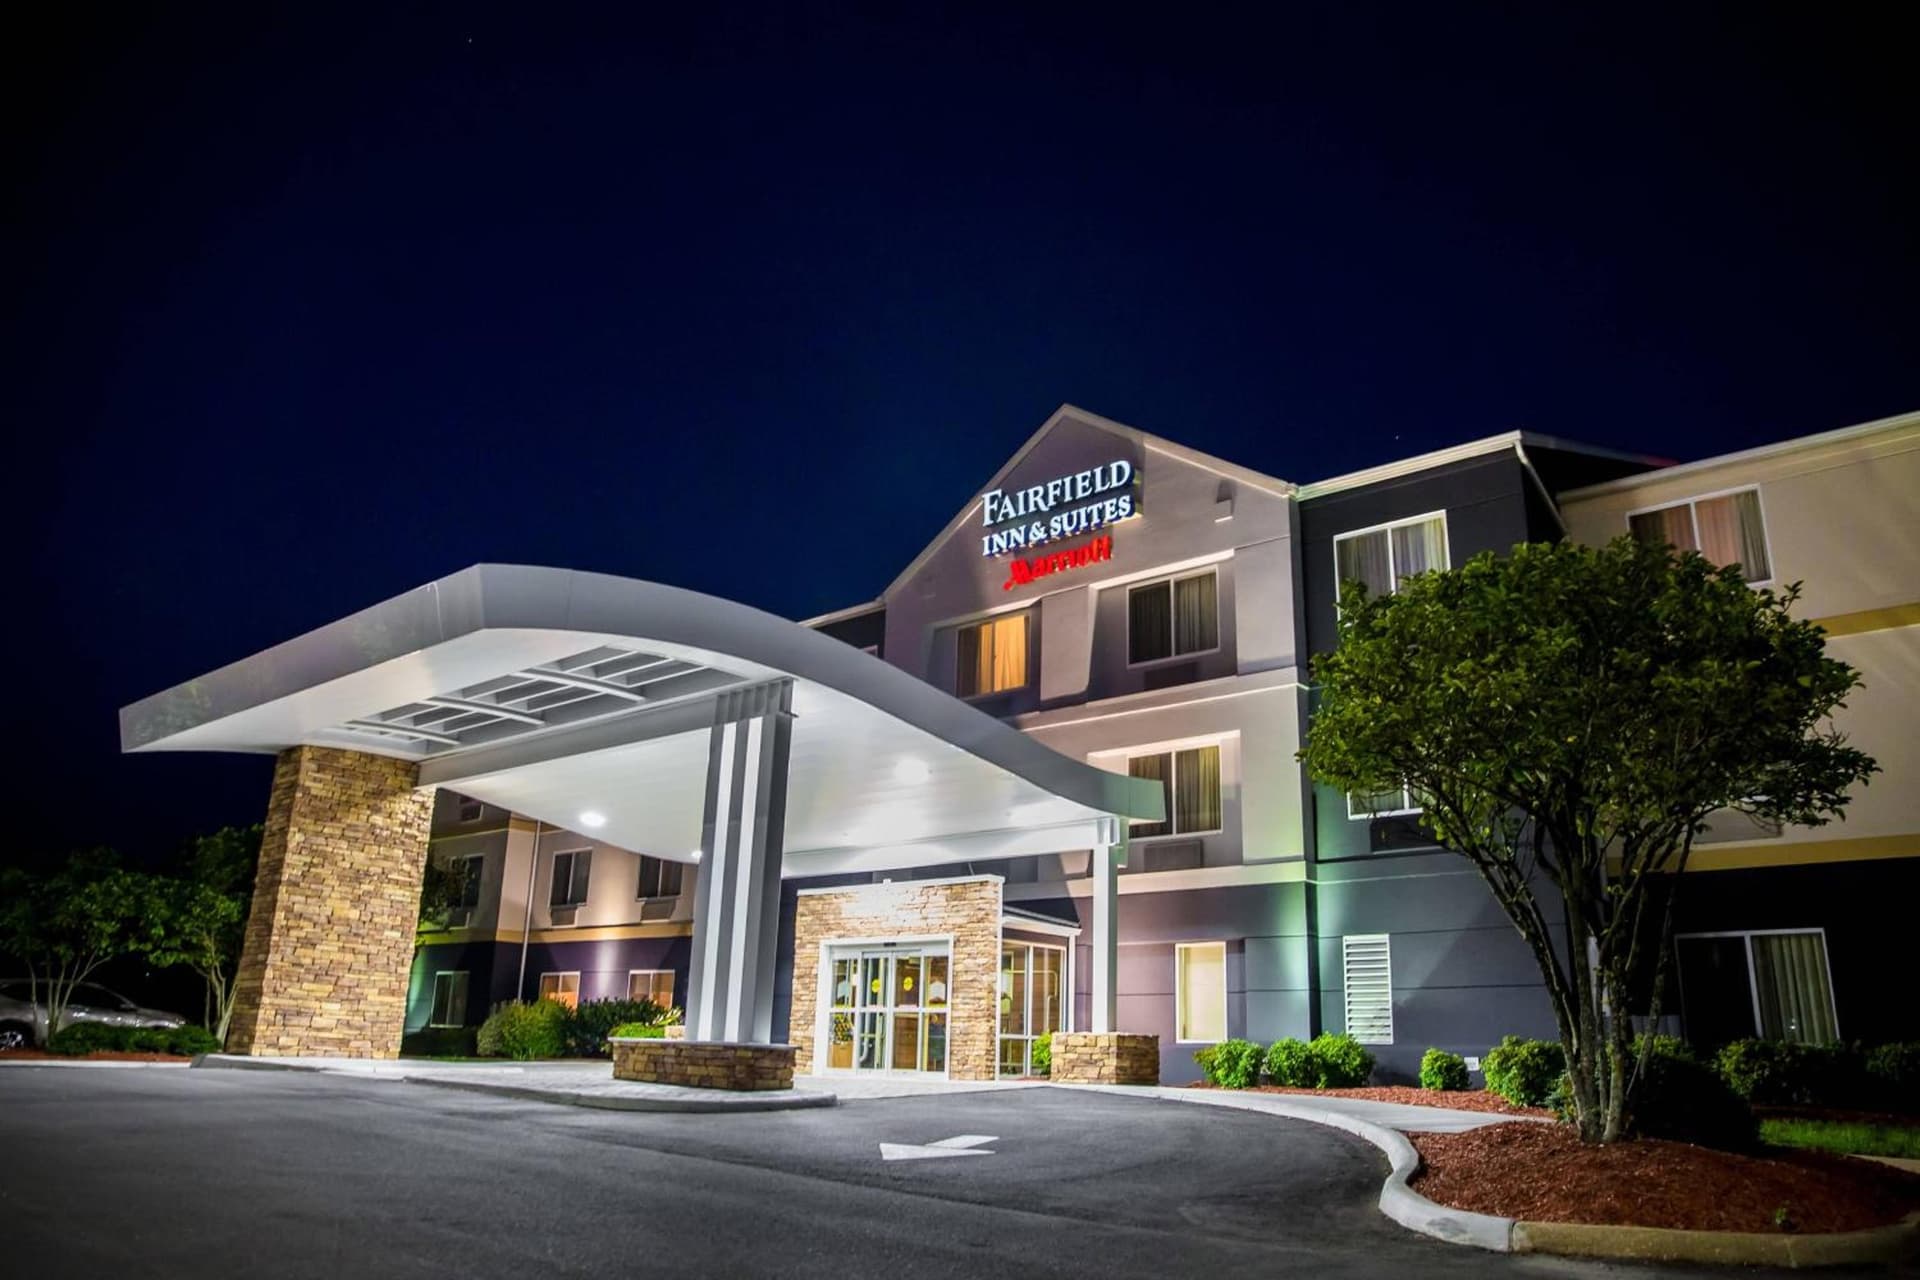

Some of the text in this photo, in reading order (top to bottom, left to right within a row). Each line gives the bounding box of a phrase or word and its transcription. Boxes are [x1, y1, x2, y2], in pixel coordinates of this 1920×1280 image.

[982, 460, 1131, 527] FAIRFIELD
[982, 495, 1131, 556] INN & SUITES
[1003, 534, 1112, 591] Marriott
